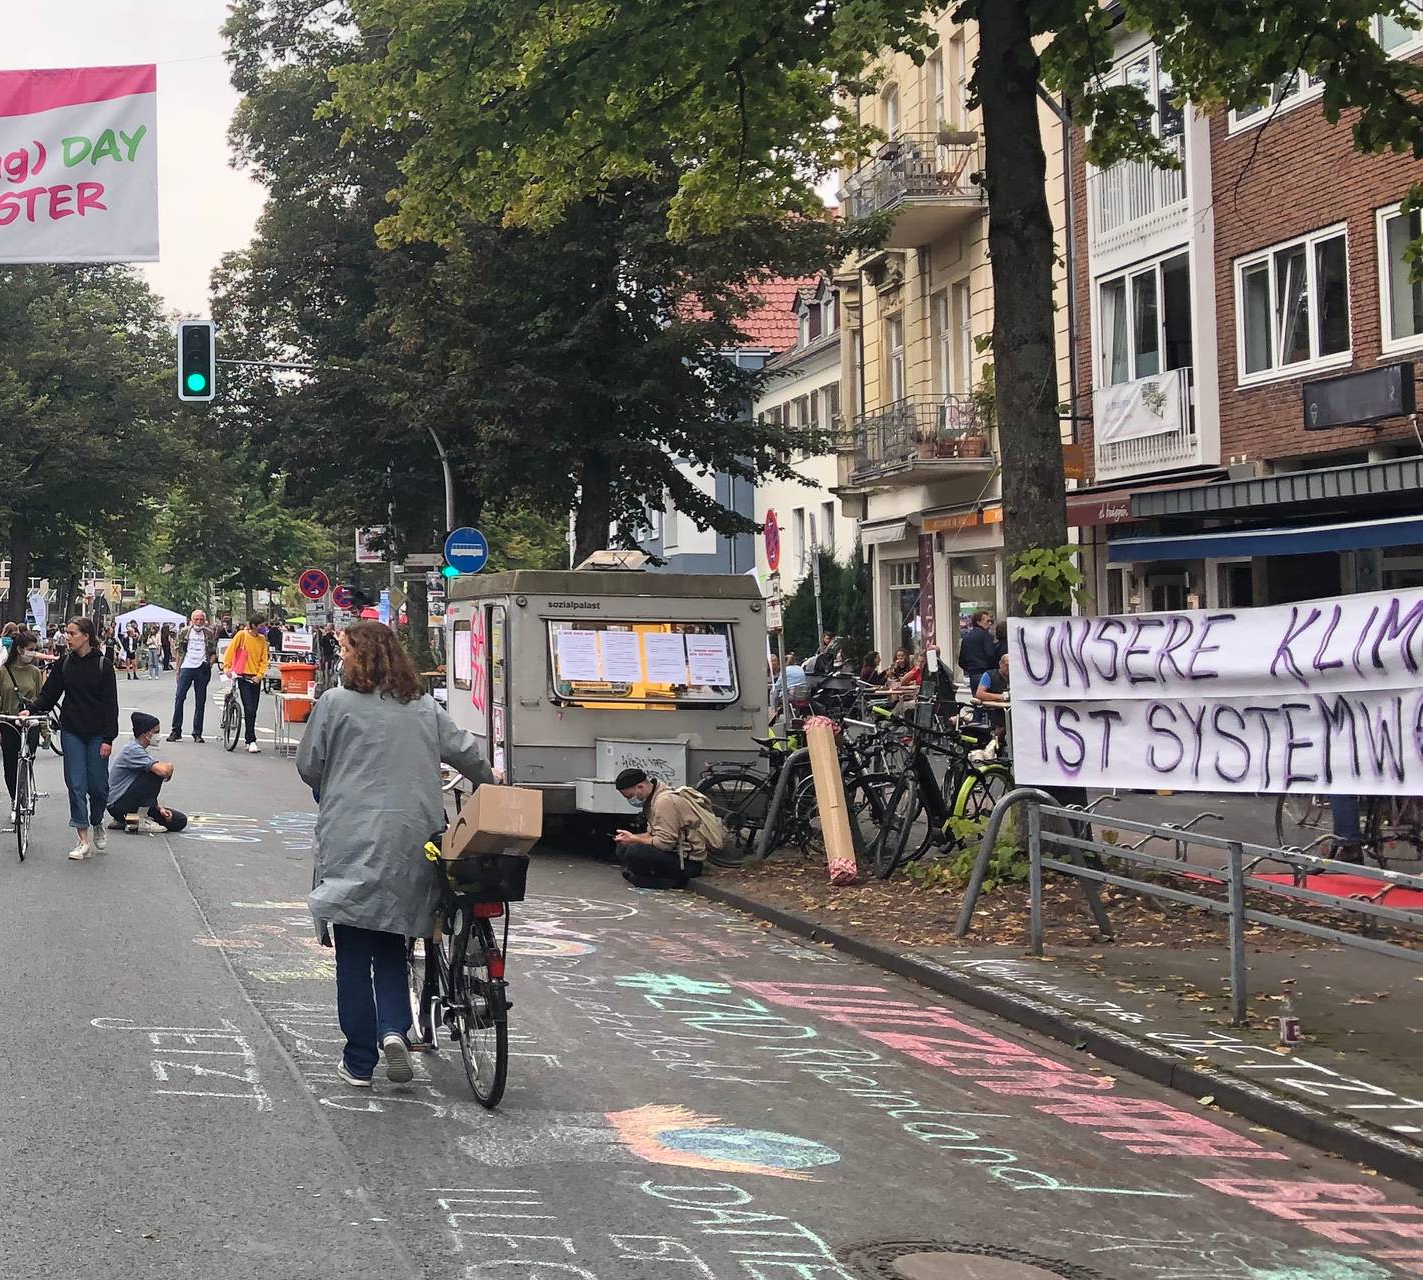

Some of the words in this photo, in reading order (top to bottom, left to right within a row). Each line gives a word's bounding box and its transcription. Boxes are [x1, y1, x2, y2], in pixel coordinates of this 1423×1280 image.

[60, 125, 147, 168] DAY
[548, 601, 601, 609] sozialpalast
[953, 574, 996, 587] WELTLADEN
[1017, 614, 1236, 688] UNSERE
[1270, 597, 1423, 686] KLIM
[1039, 705, 1121, 775] IST
[90, 1017, 273, 1112] JETZT
